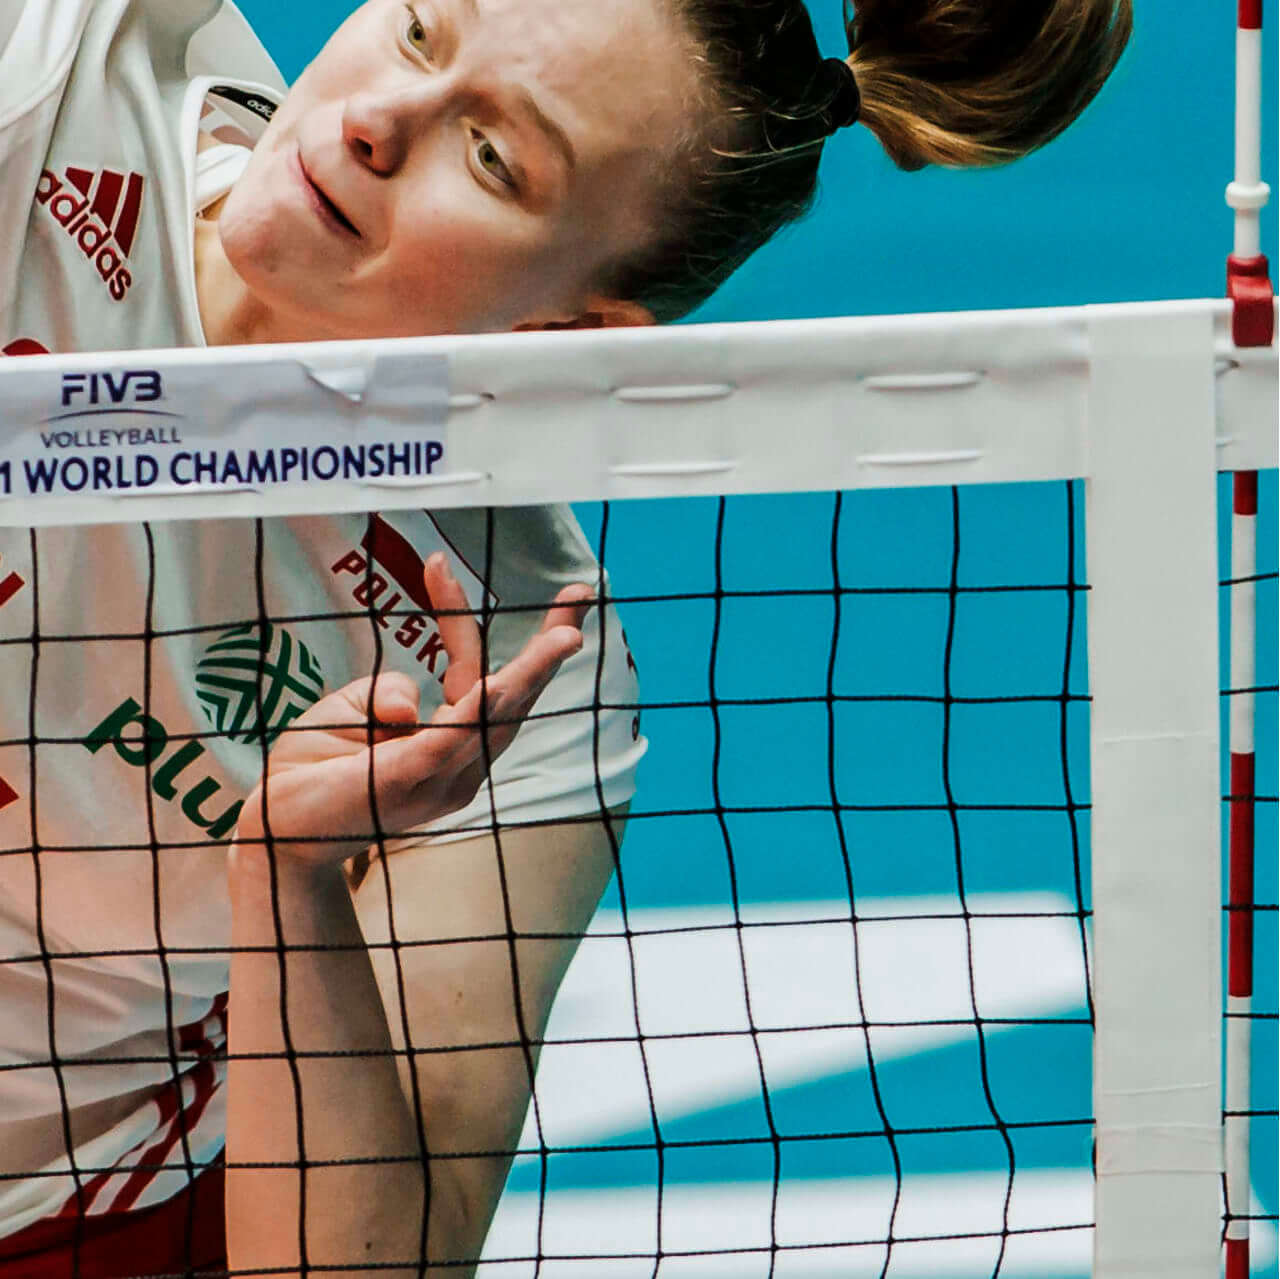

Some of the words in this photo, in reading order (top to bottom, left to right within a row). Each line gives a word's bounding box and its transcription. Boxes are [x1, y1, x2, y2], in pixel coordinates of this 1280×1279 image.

[36, 168, 134, 303] adidas
[23, 453, 159, 494] WORLD
[169, 441, 444, 487] CHAMPIONSHIP
[40, 426, 182, 449] VOLLEYBALL
[331, 549, 448, 685] POLSK
[80, 696, 246, 840] plu
